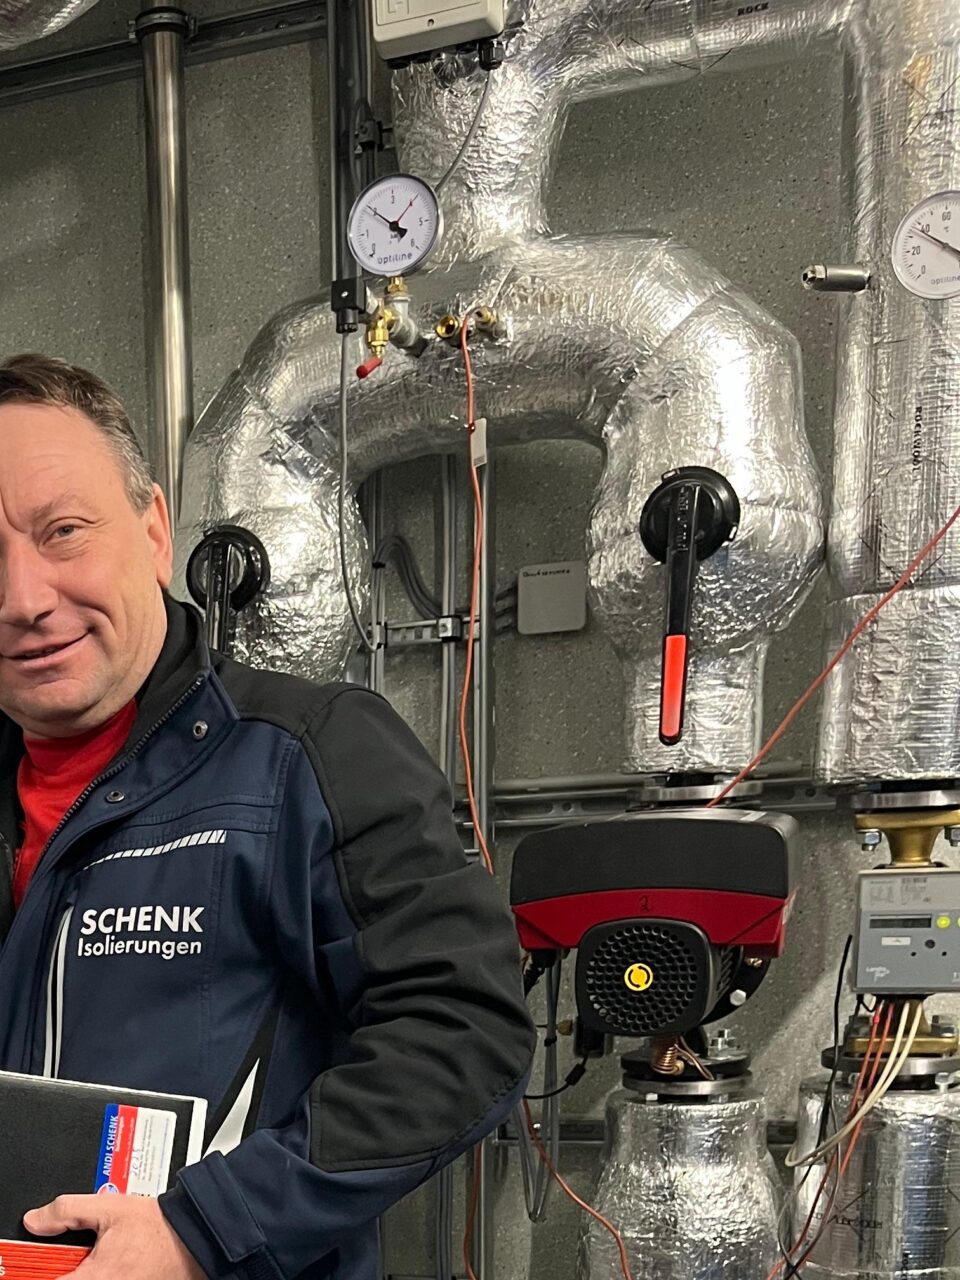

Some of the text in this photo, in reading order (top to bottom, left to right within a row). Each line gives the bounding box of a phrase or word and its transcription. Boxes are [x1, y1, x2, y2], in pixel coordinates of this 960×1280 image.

[418, 217, 424, 226] 5
[942, 211, 952, 221] 60
[912, 246, 921, 255] 20
[377, 252, 413, 264] optiline
[921, 265, 926, 274] 0
[912, 406, 922, 472] ROCKWOOL
[80, 905, 205, 935] SCHENK
[77, 934, 202, 960] Isolierungen
[102, 1115, 119, 1177] ANDI SCHENK
